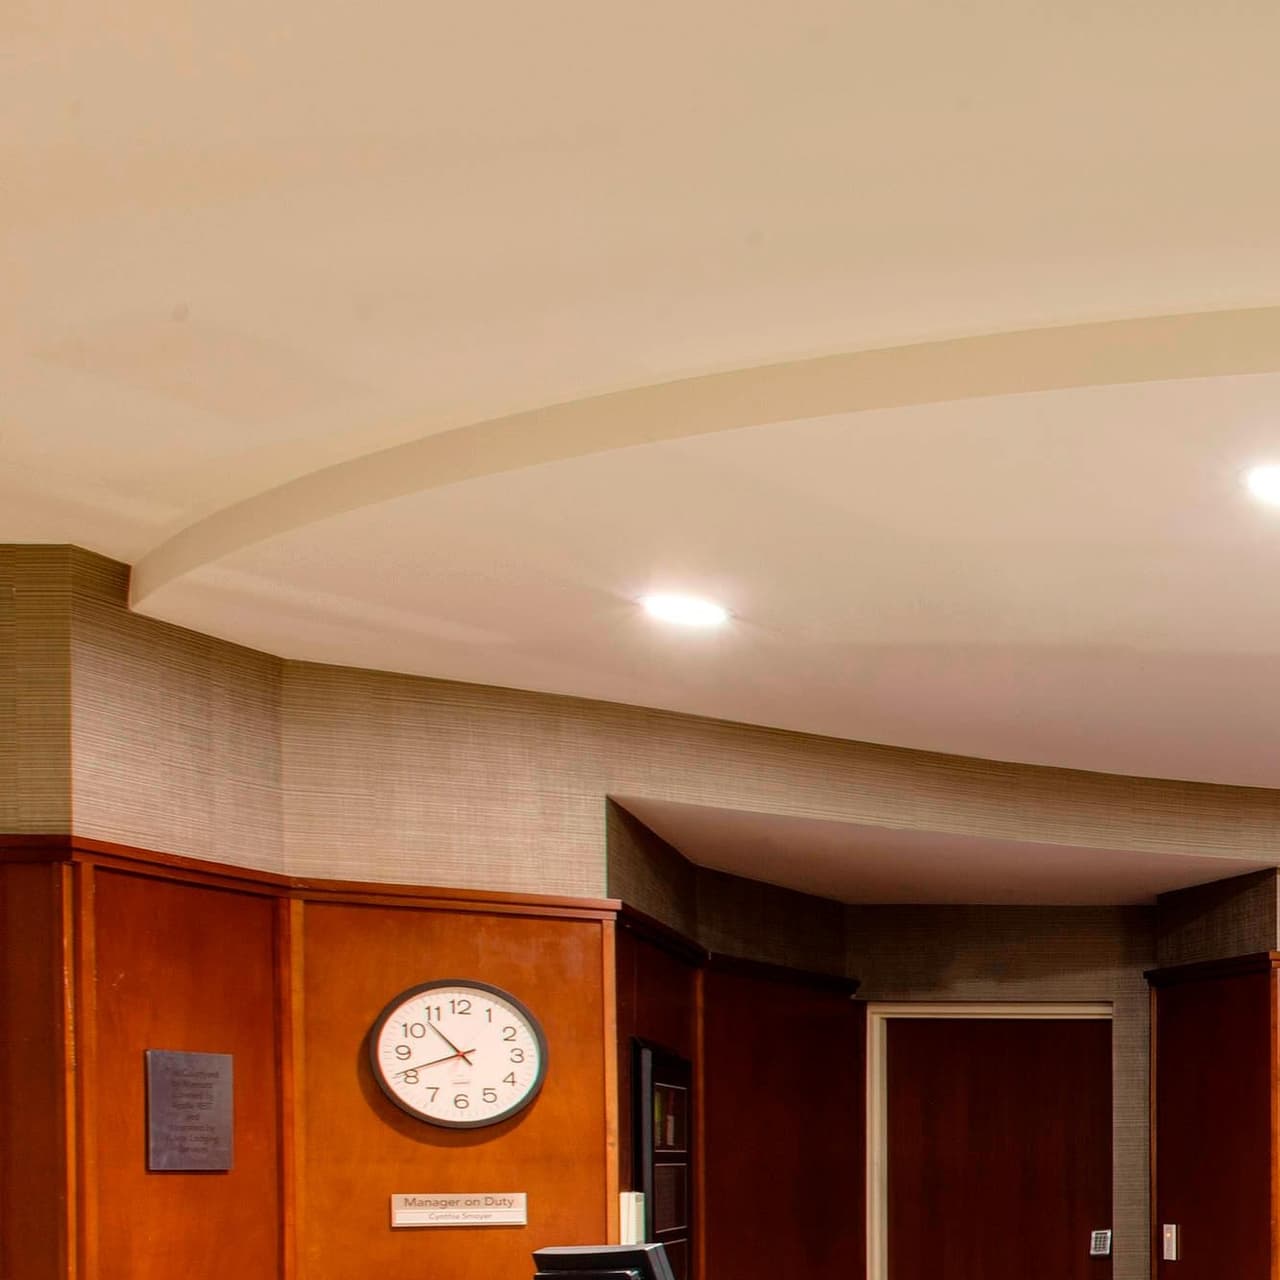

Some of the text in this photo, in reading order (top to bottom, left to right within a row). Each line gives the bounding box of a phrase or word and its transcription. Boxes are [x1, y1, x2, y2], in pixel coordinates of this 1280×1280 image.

[425, 1006, 442, 1021] 11
[450, 1000, 472, 1015] 12
[486, 1008, 492, 1023] 1
[402, 1022, 426, 1038] 10
[503, 1026, 518, 1042] 2
[395, 1045, 412, 1060] 9
[510, 1048, 524, 1064] 3
[404, 1069, 419, 1084] 8
[502, 1072, 516, 1086] 4
[426, 1087, 440, 1103] 7
[454, 1094, 470, 1109] 6
[482, 1088, 498, 1104] 5
[404, 1197, 514, 1209] Manager on Duty
